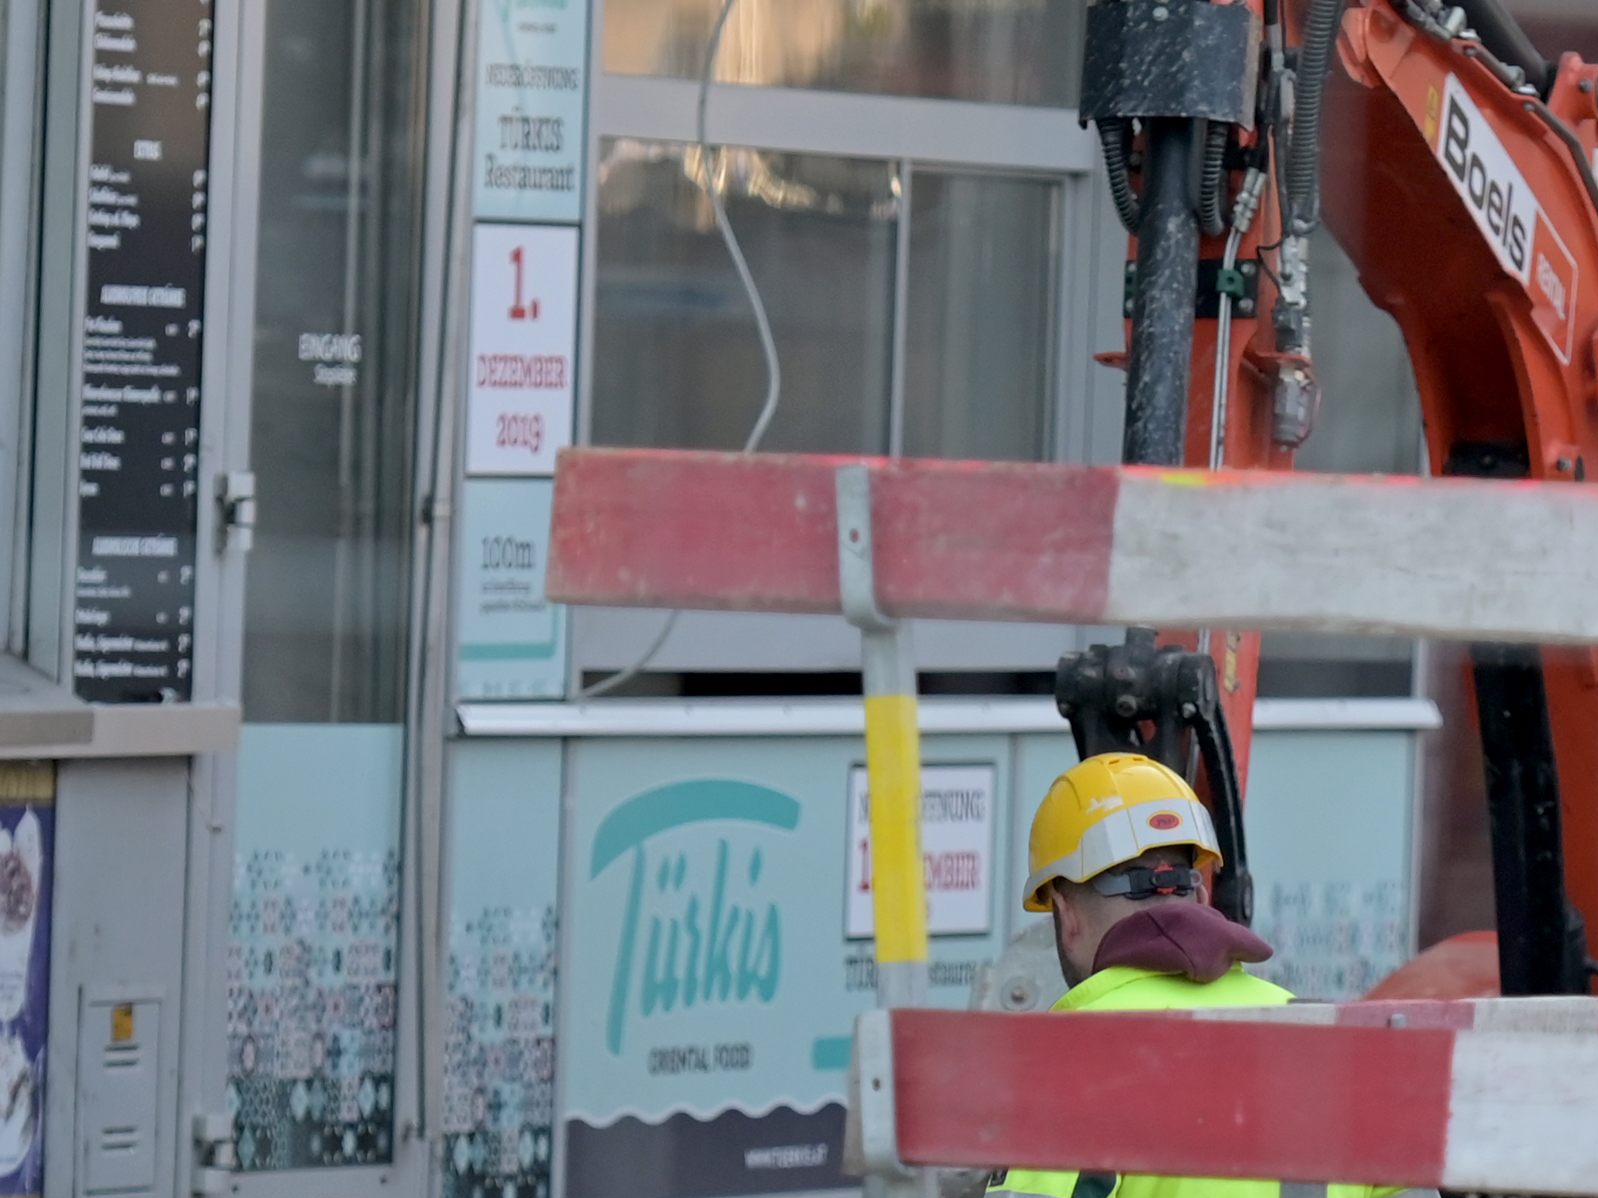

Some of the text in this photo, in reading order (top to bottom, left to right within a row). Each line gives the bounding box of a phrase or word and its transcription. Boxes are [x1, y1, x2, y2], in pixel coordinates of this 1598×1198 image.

[498, 106, 564, 153] TÜRKIS
[484, 153, 576, 193] Restaurant
[1443, 94, 1528, 272] Boels
[508, 244, 542, 321] 1.
[297, 332, 363, 363] EINGANG
[476, 353, 568, 390] DEZEMBER
[496, 412, 545, 454] 2019
[480, 535, 536, 570] 100m
[590, 777, 801, 1057] Türkis
[648, 1041, 754, 1076] ORIENTAL FOOD
